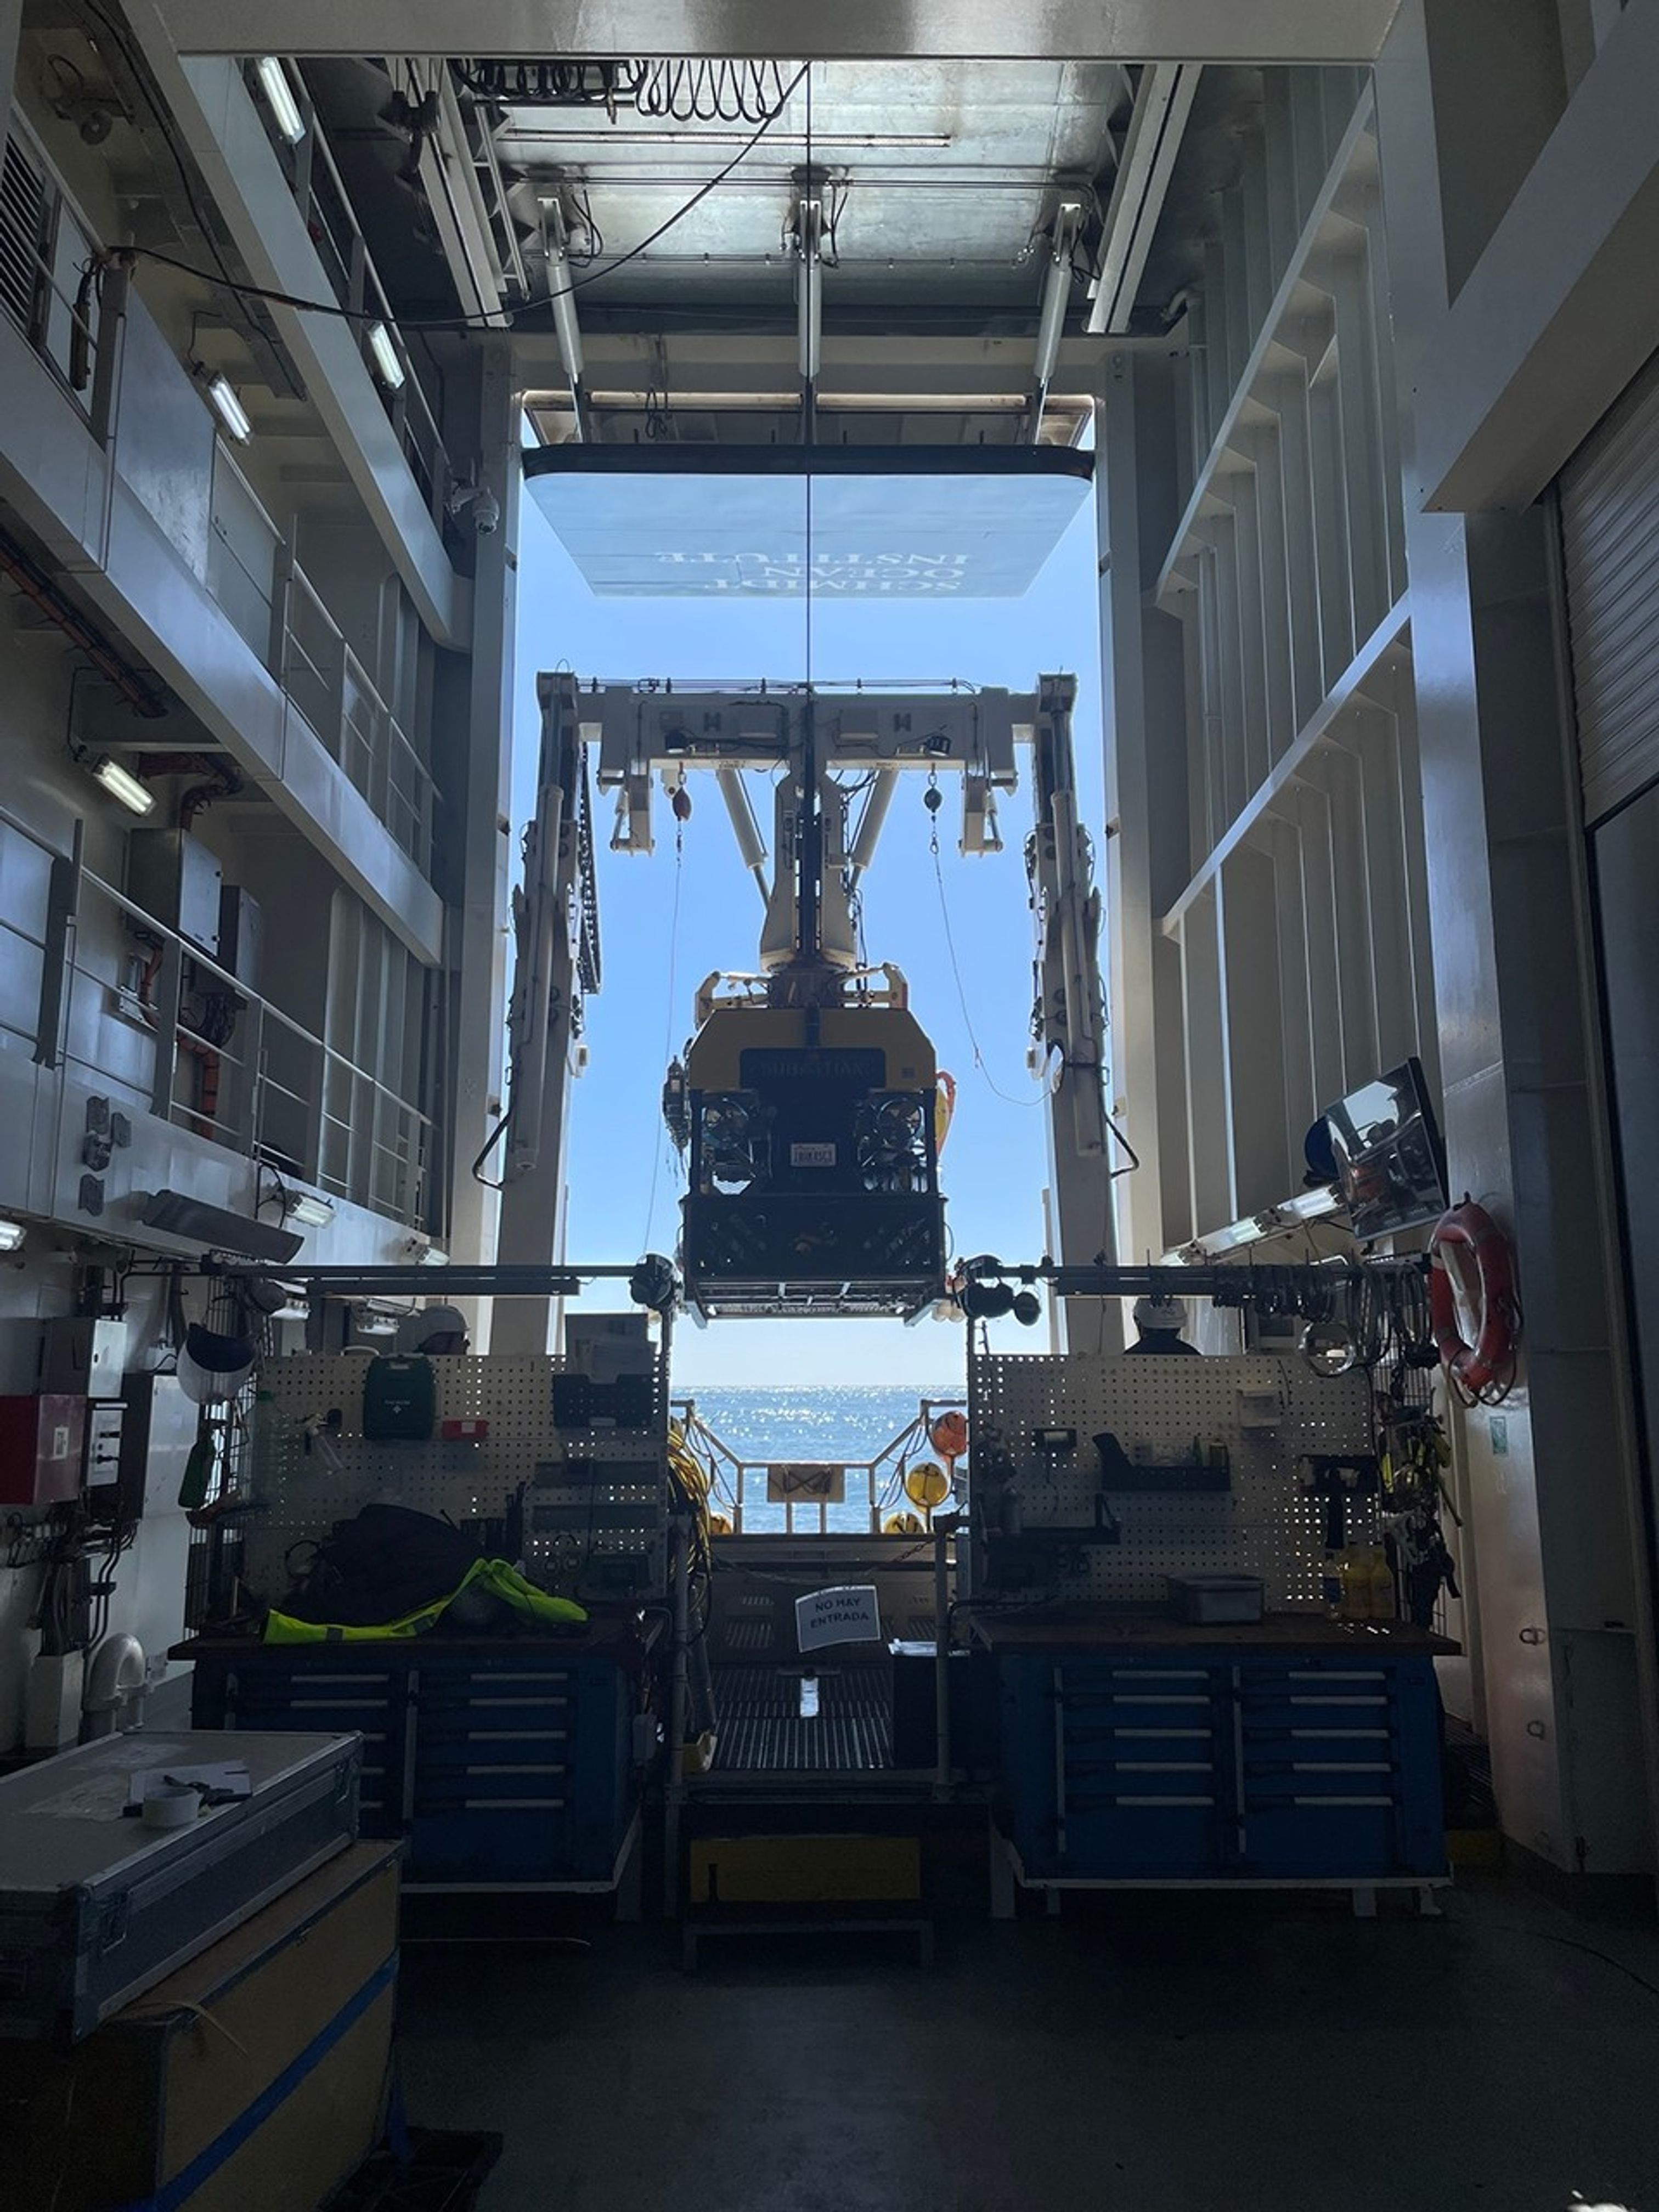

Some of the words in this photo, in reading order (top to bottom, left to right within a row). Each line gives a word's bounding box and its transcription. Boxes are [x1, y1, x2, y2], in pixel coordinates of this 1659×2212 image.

[653, 552, 969, 565] INSTITUTE
[763, 567, 964, 579] OCEAN
[703, 579, 962, 590] SCHMIDT
[815, 1599, 833, 1612] NO
[836, 1597, 861, 1607] HAY
[810, 1611, 869, 1628] ENTRADA
